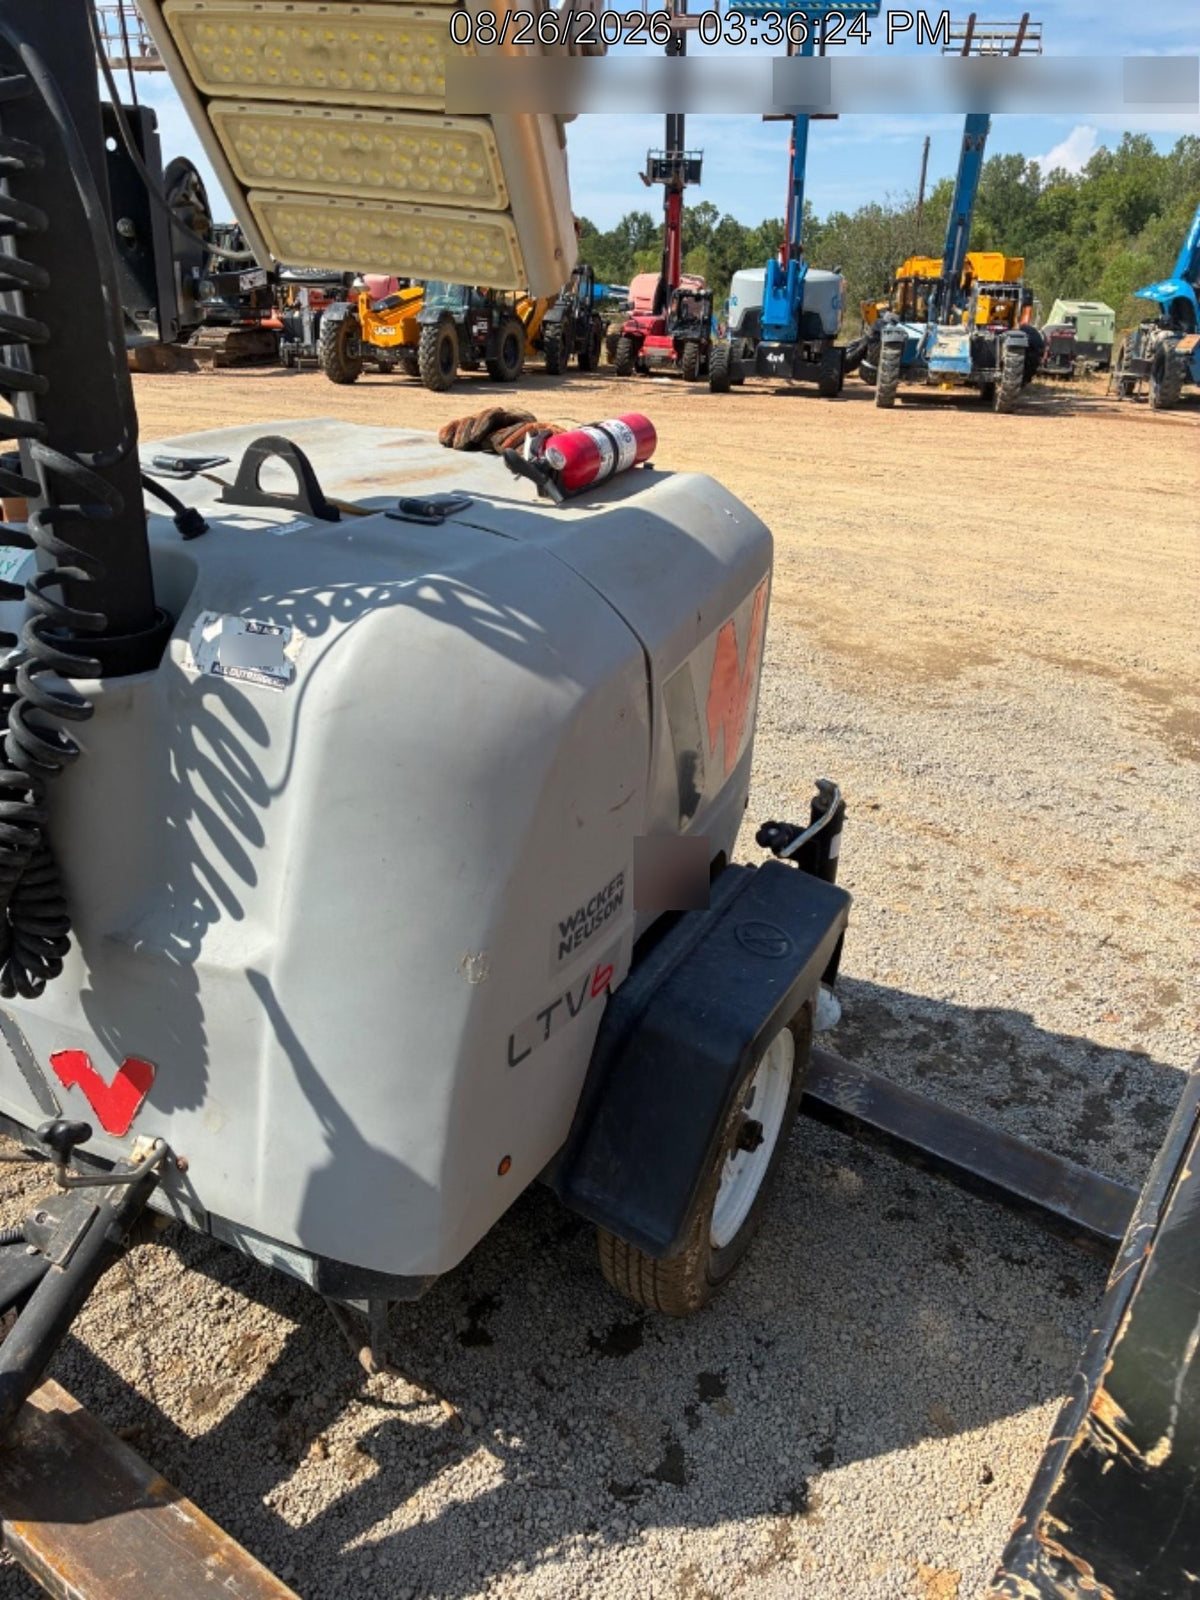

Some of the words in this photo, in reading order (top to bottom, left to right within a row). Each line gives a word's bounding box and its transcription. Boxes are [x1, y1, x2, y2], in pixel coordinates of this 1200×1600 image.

[558, 871, 625, 938] WACKER
[558, 888, 625, 960] NEUSON
[508, 963, 614, 1068] LTV6
